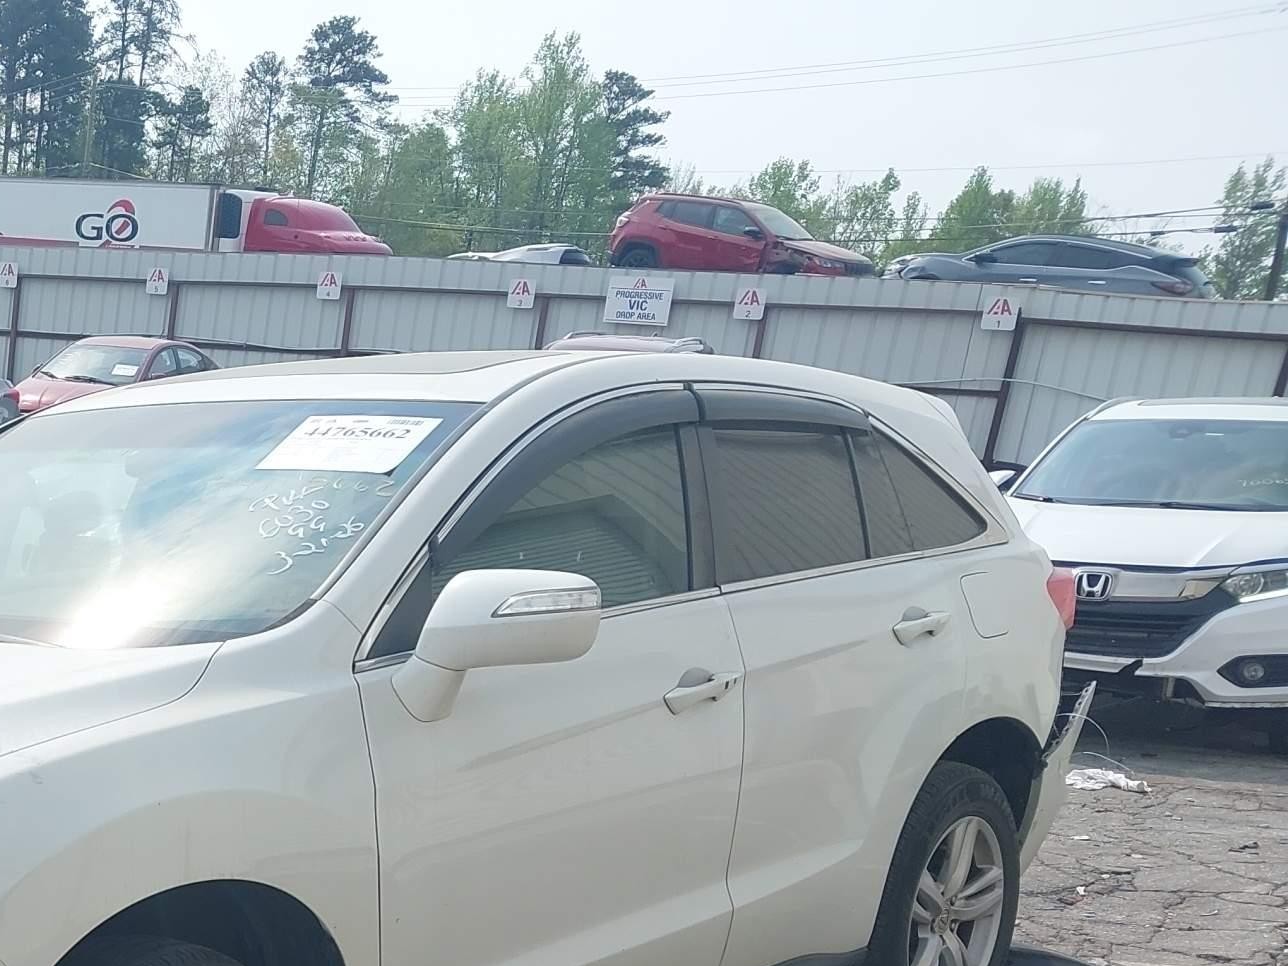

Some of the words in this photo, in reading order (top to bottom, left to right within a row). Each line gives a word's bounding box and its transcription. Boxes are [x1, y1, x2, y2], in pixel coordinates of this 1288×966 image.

[75, 213, 139, 242] GO
[616, 290, 664, 300] PROGRESSIVE
[628, 299, 648, 311] VIC
[616, 311, 635, 319] DROP
[637, 312, 656, 320] AREA
[304, 426, 411, 439] 44765662
